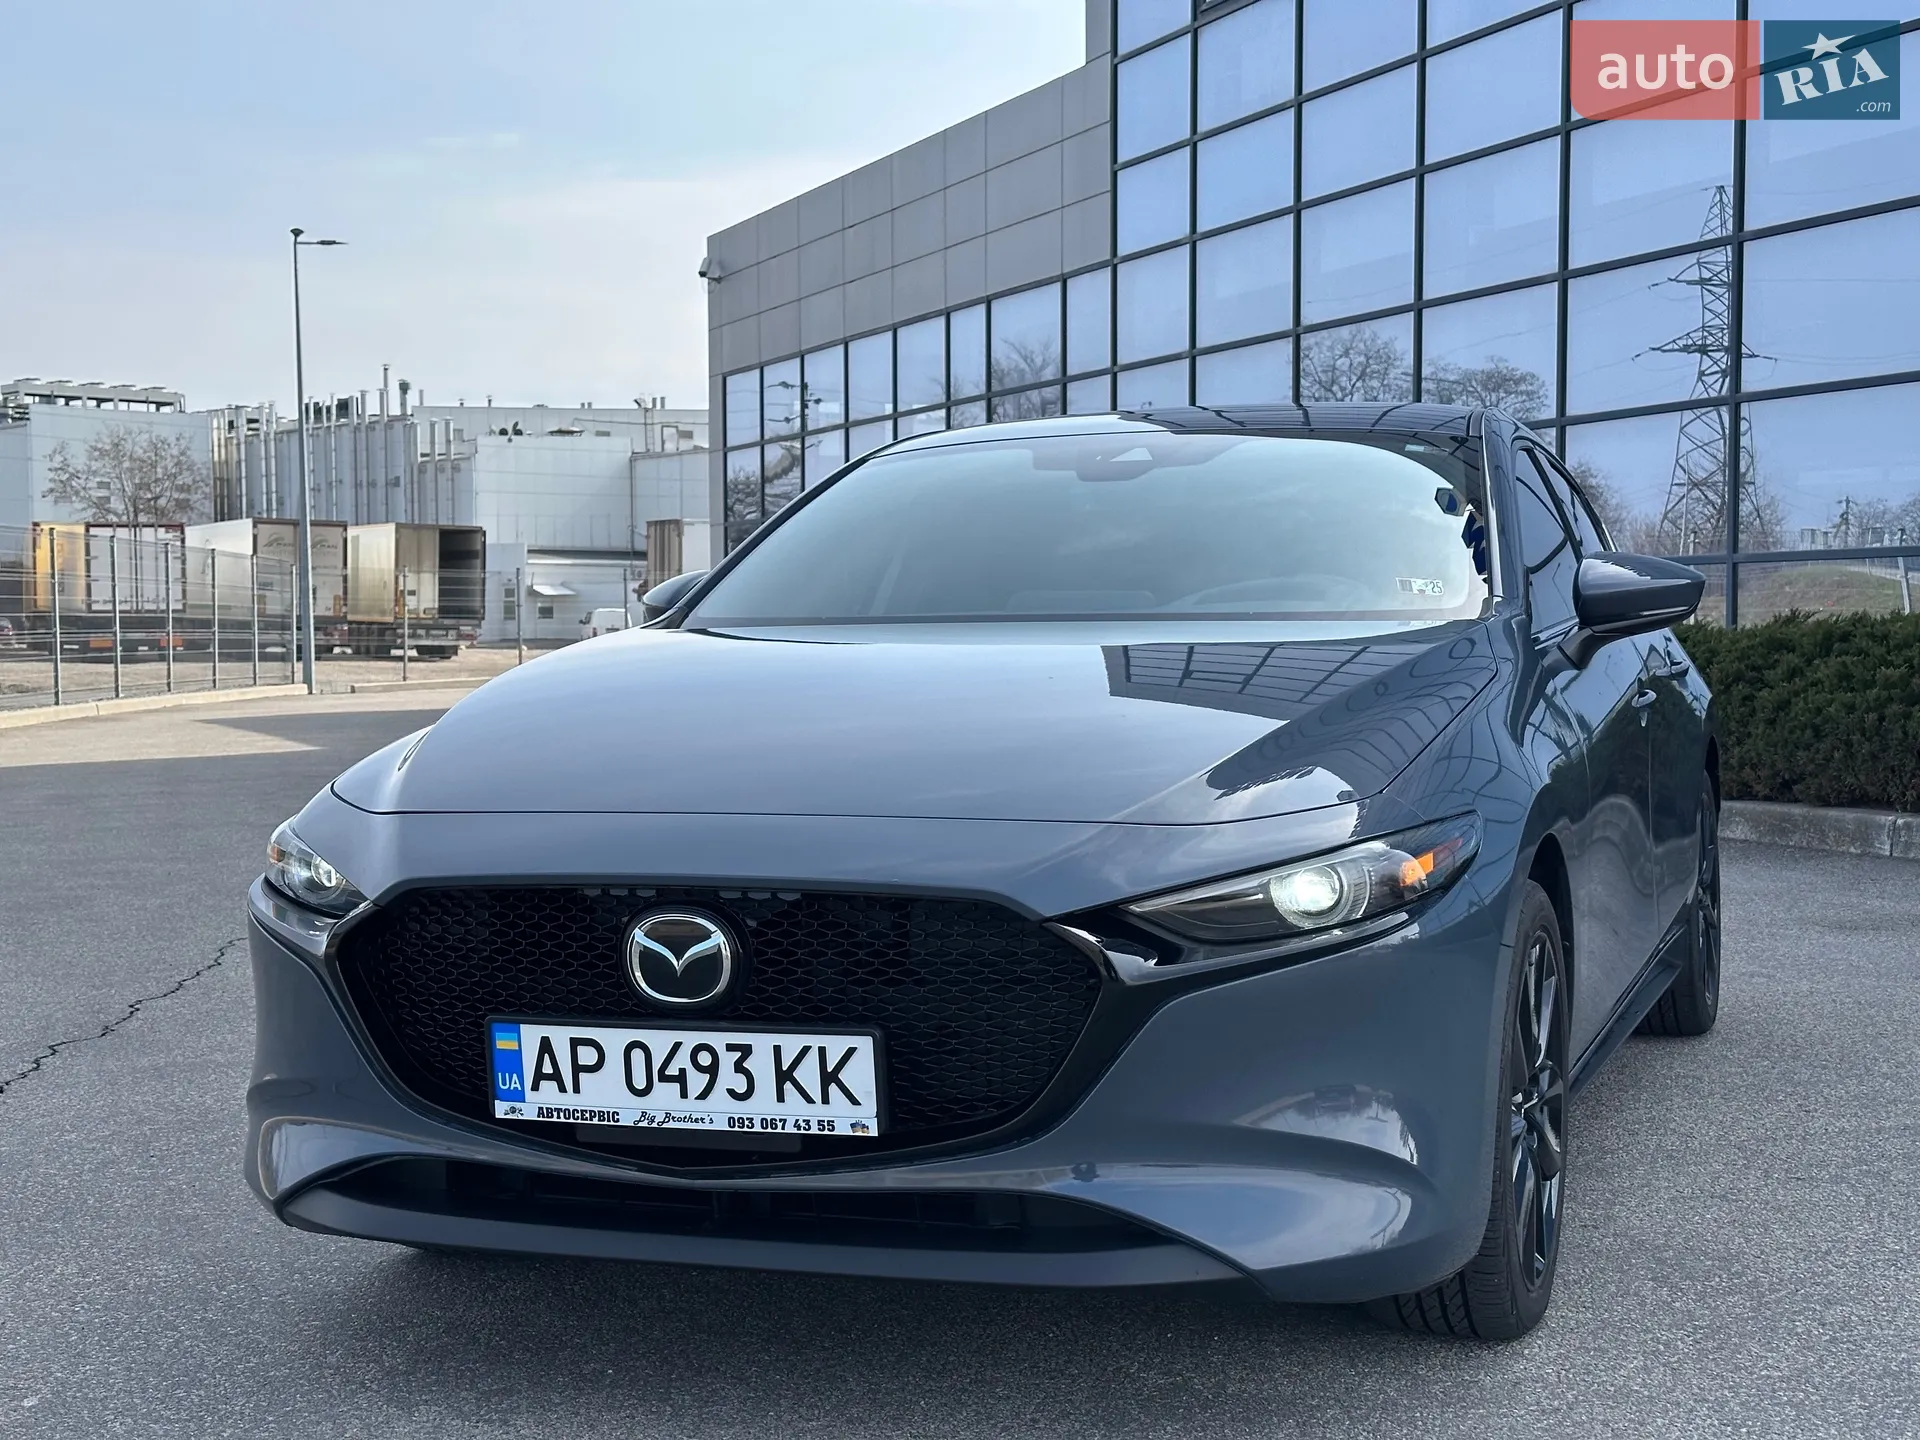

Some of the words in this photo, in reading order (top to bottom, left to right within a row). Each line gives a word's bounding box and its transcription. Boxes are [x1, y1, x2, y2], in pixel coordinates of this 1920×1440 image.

[1430, 580, 1442, 594] 25
[531, 1035, 606, 1094] AP
[623, 1039, 756, 1102] 0493
[773, 1044, 862, 1106] KK
[498, 1072, 522, 1091] UA
[536, 1106, 620, 1124] АВТОСЕРВІС
[633, 1110, 657, 1126] Big
[657, 1111, 714, 1127] Brother's
[727, 1116, 755, 1130] 093
[760, 1117, 788, 1131] 067
[793, 1118, 812, 1132] 43
[817, 1119, 836, 1132] 55
